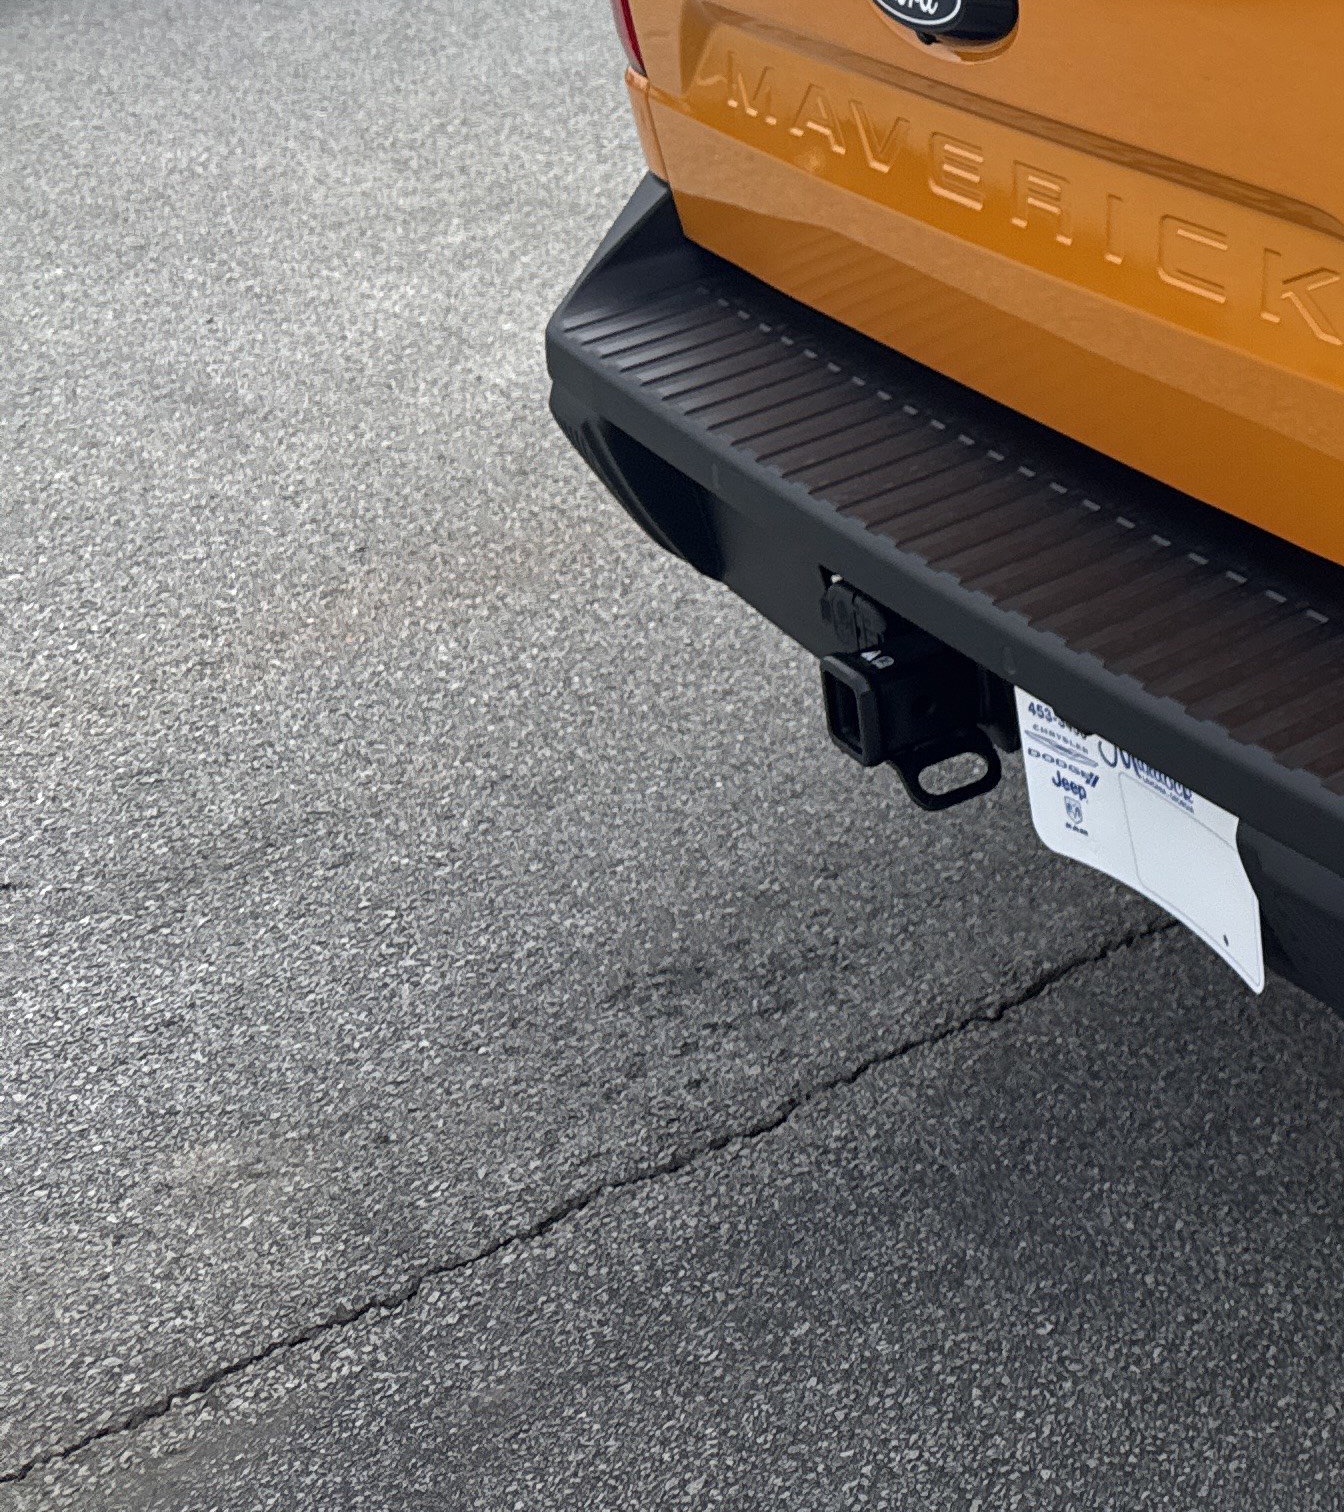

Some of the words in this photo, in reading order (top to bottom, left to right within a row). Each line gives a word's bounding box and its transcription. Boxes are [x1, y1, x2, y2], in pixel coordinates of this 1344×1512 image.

[726, 48, 1344, 346] MAVERICK
[1033, 724, 1089, 754] CHRYSLER
[1028, 748, 1091, 780] DODGE
[1052, 770, 1087, 801] Jeep
